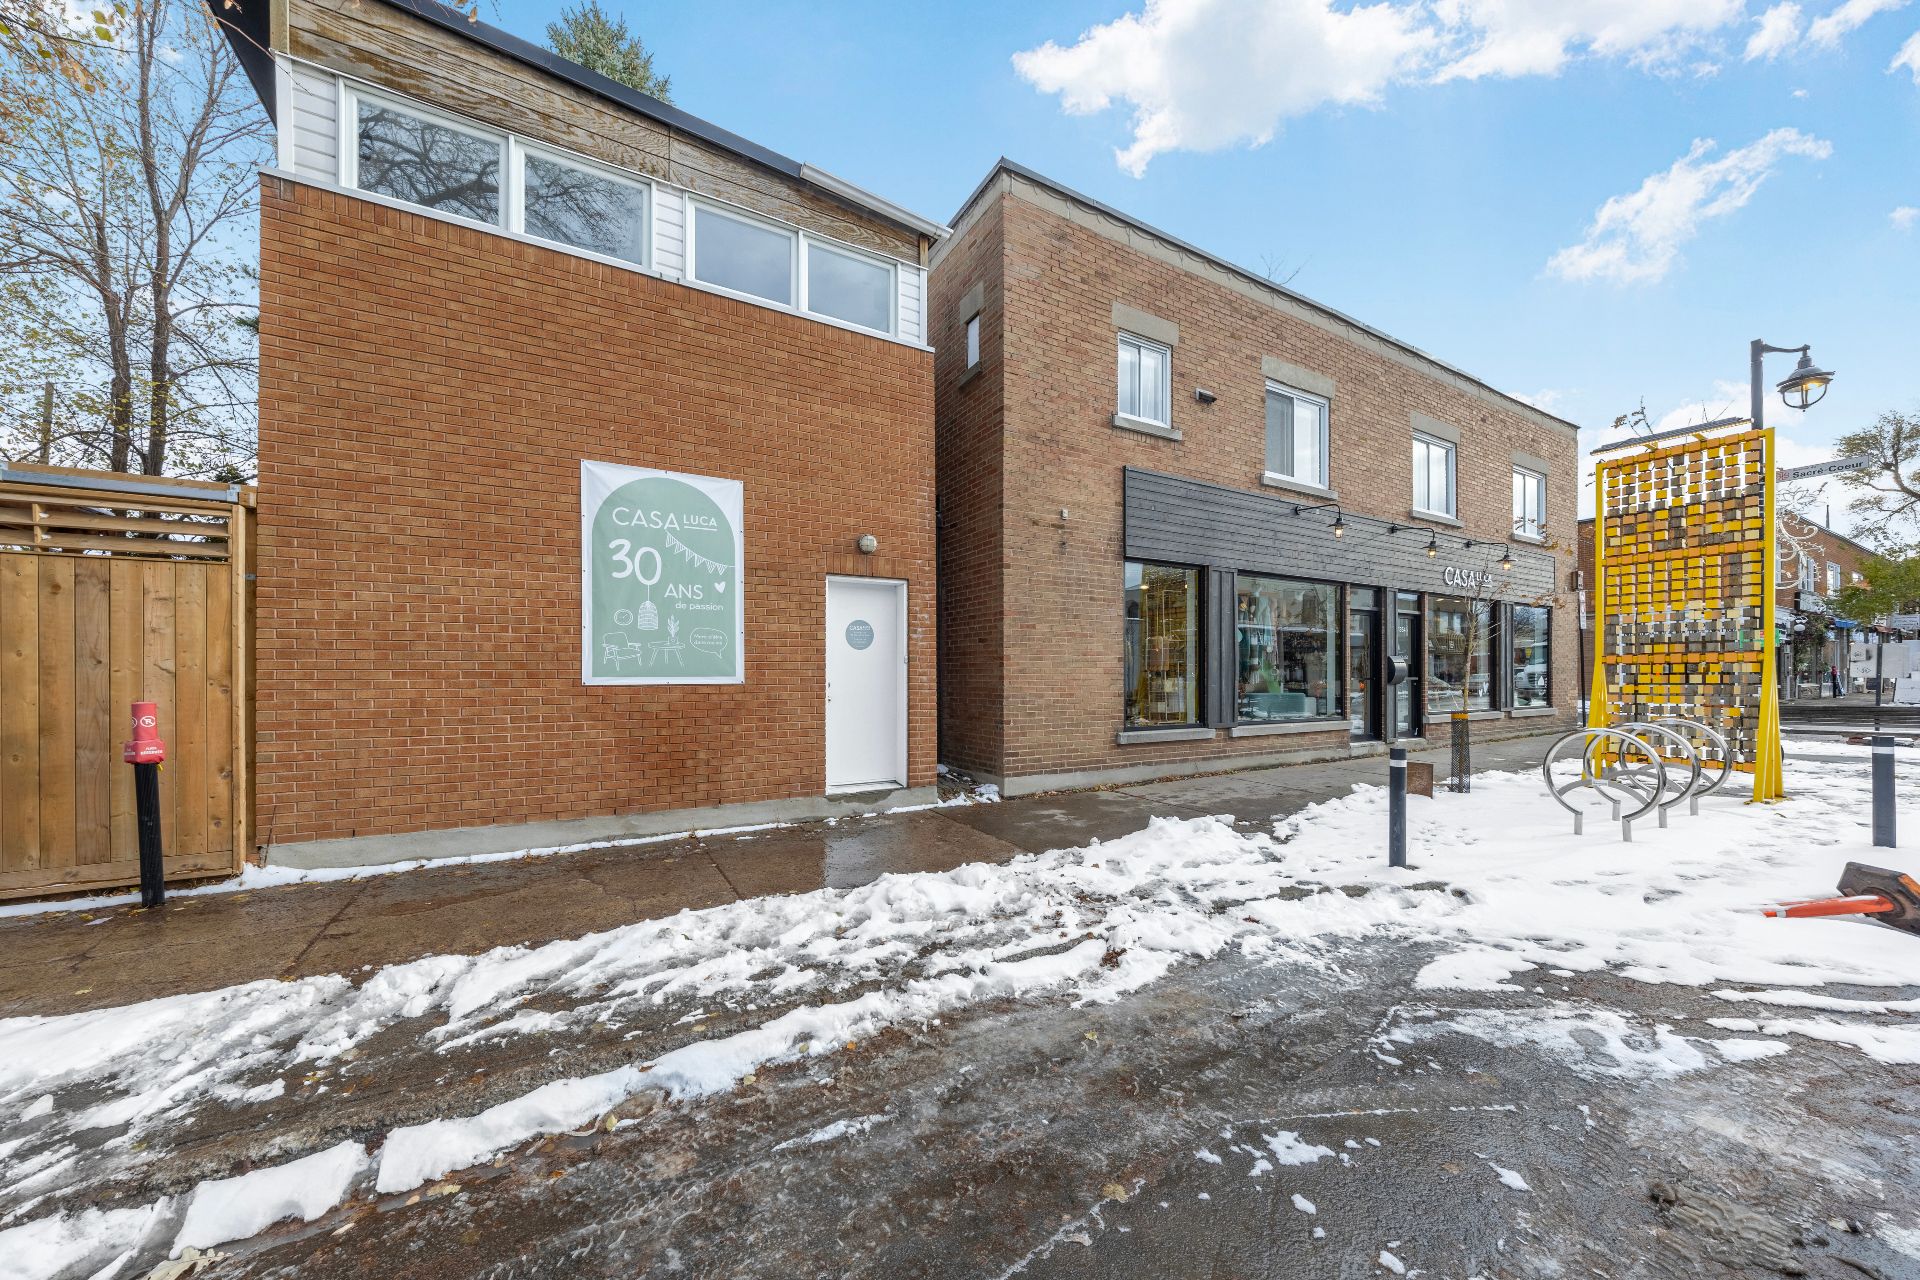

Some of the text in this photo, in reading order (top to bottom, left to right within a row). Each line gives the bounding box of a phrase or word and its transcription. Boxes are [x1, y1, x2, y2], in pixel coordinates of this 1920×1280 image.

[612, 507, 718, 531] CASA LUCA
[609, 538, 662, 586] 30
[1445, 566, 1476, 589] CASA
[664, 583, 704, 600] ANS
[675, 601, 724, 611] de passion
